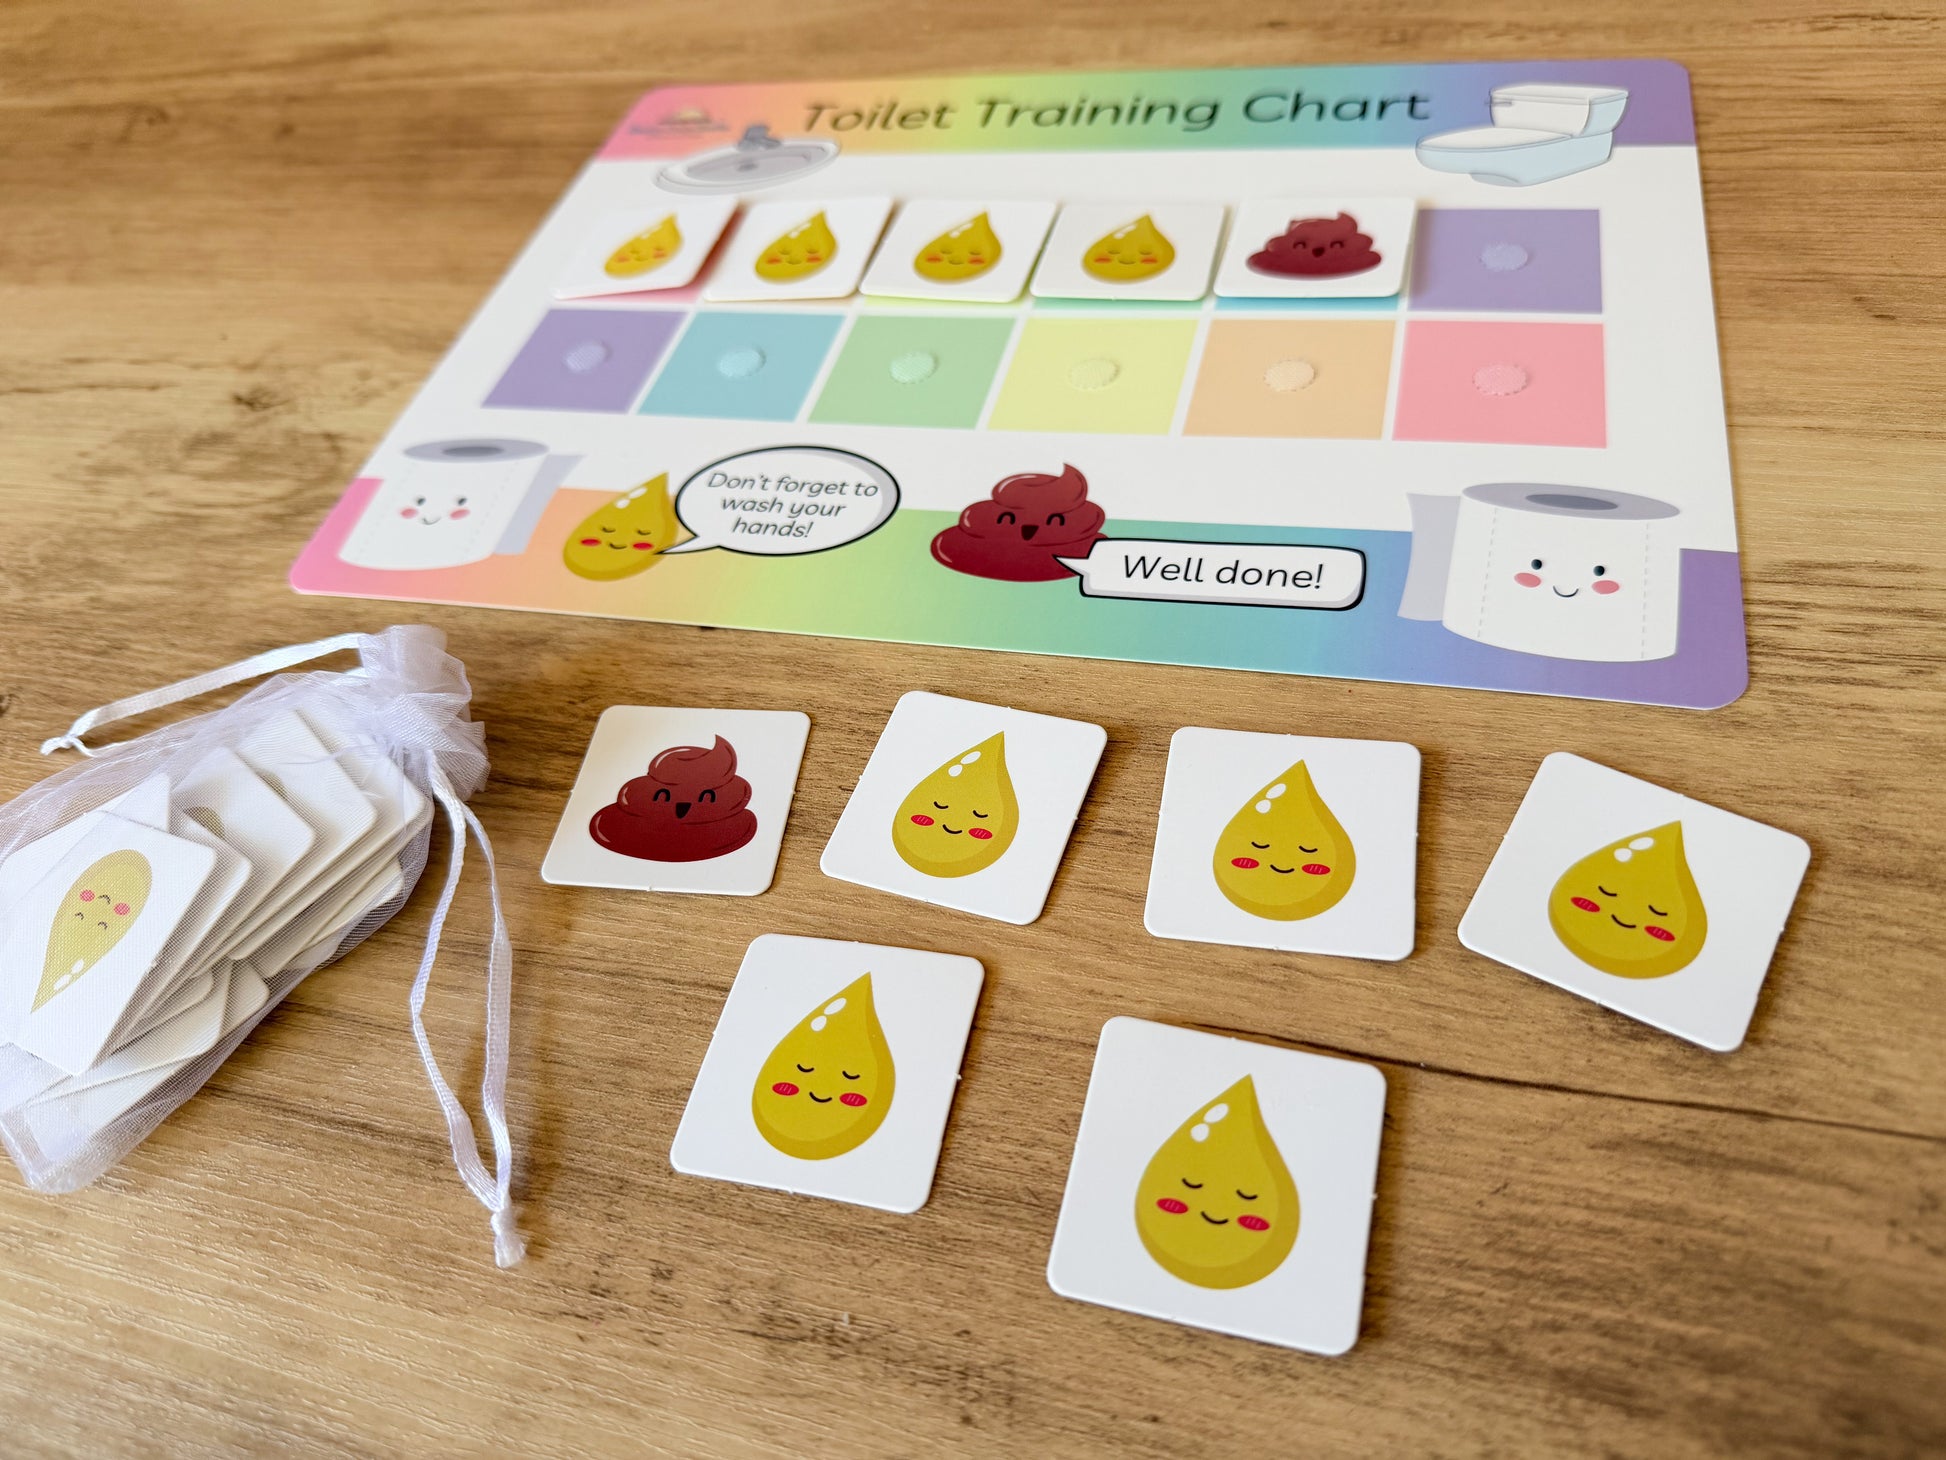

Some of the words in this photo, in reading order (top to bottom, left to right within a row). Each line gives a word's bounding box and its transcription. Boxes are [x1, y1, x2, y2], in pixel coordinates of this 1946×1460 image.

[800, 100, 955, 132] Toilet
[975, 95, 1220, 132] Training
[1242, 88, 1431, 123] Chart
[707, 472, 772, 491] Don't
[776, 475, 849, 497] forget
[854, 482, 879, 498] to
[720, 497, 783, 514] wash
[788, 503, 846, 519] your
[732, 517, 814, 538] hands!
[1124, 554, 1204, 583] Well
[1215, 559, 1324, 590] done!
